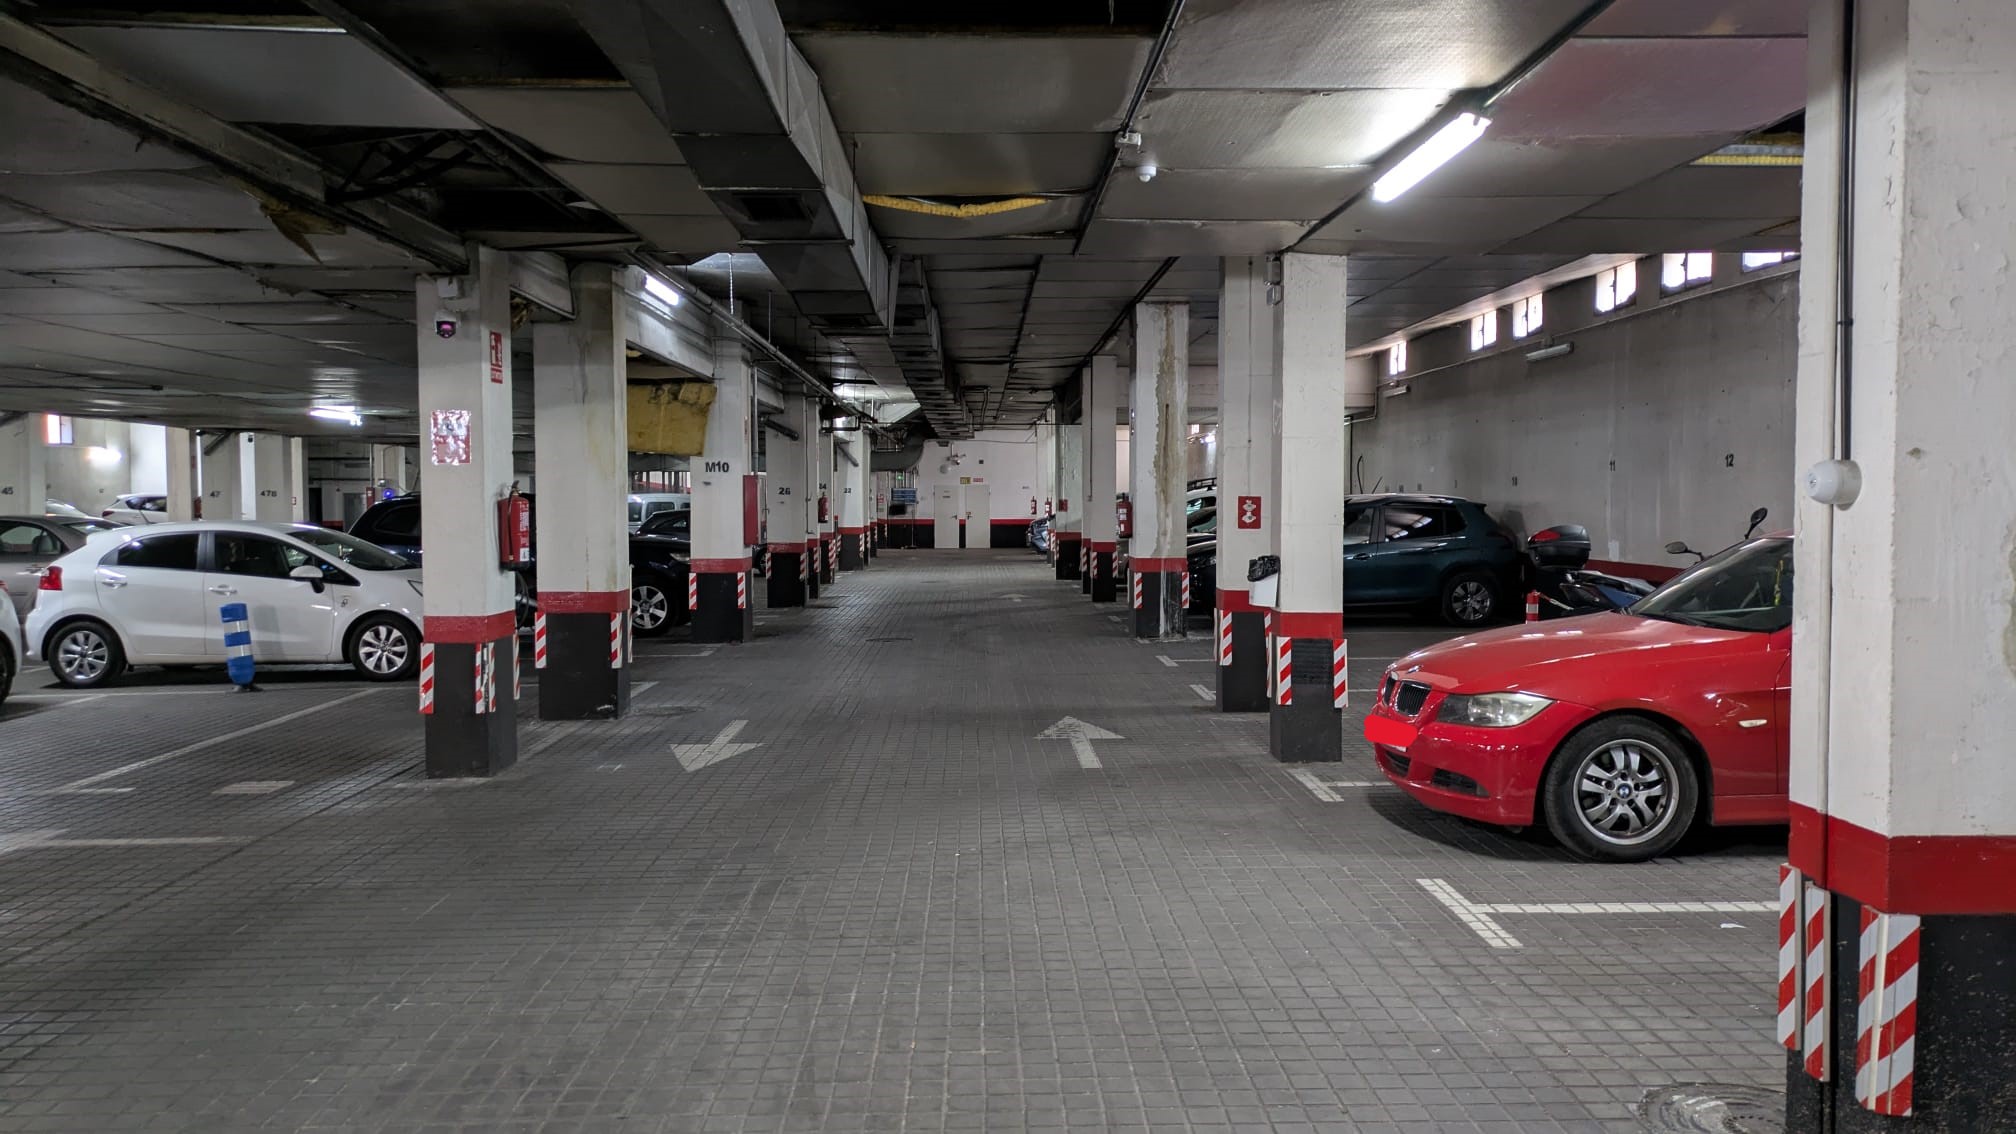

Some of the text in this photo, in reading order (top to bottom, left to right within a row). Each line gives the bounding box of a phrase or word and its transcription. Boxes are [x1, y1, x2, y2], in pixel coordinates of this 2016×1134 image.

[1725, 453, 1734, 468] 12
[705, 461, 730, 473] M10
[1, 486, 14, 495] 45
